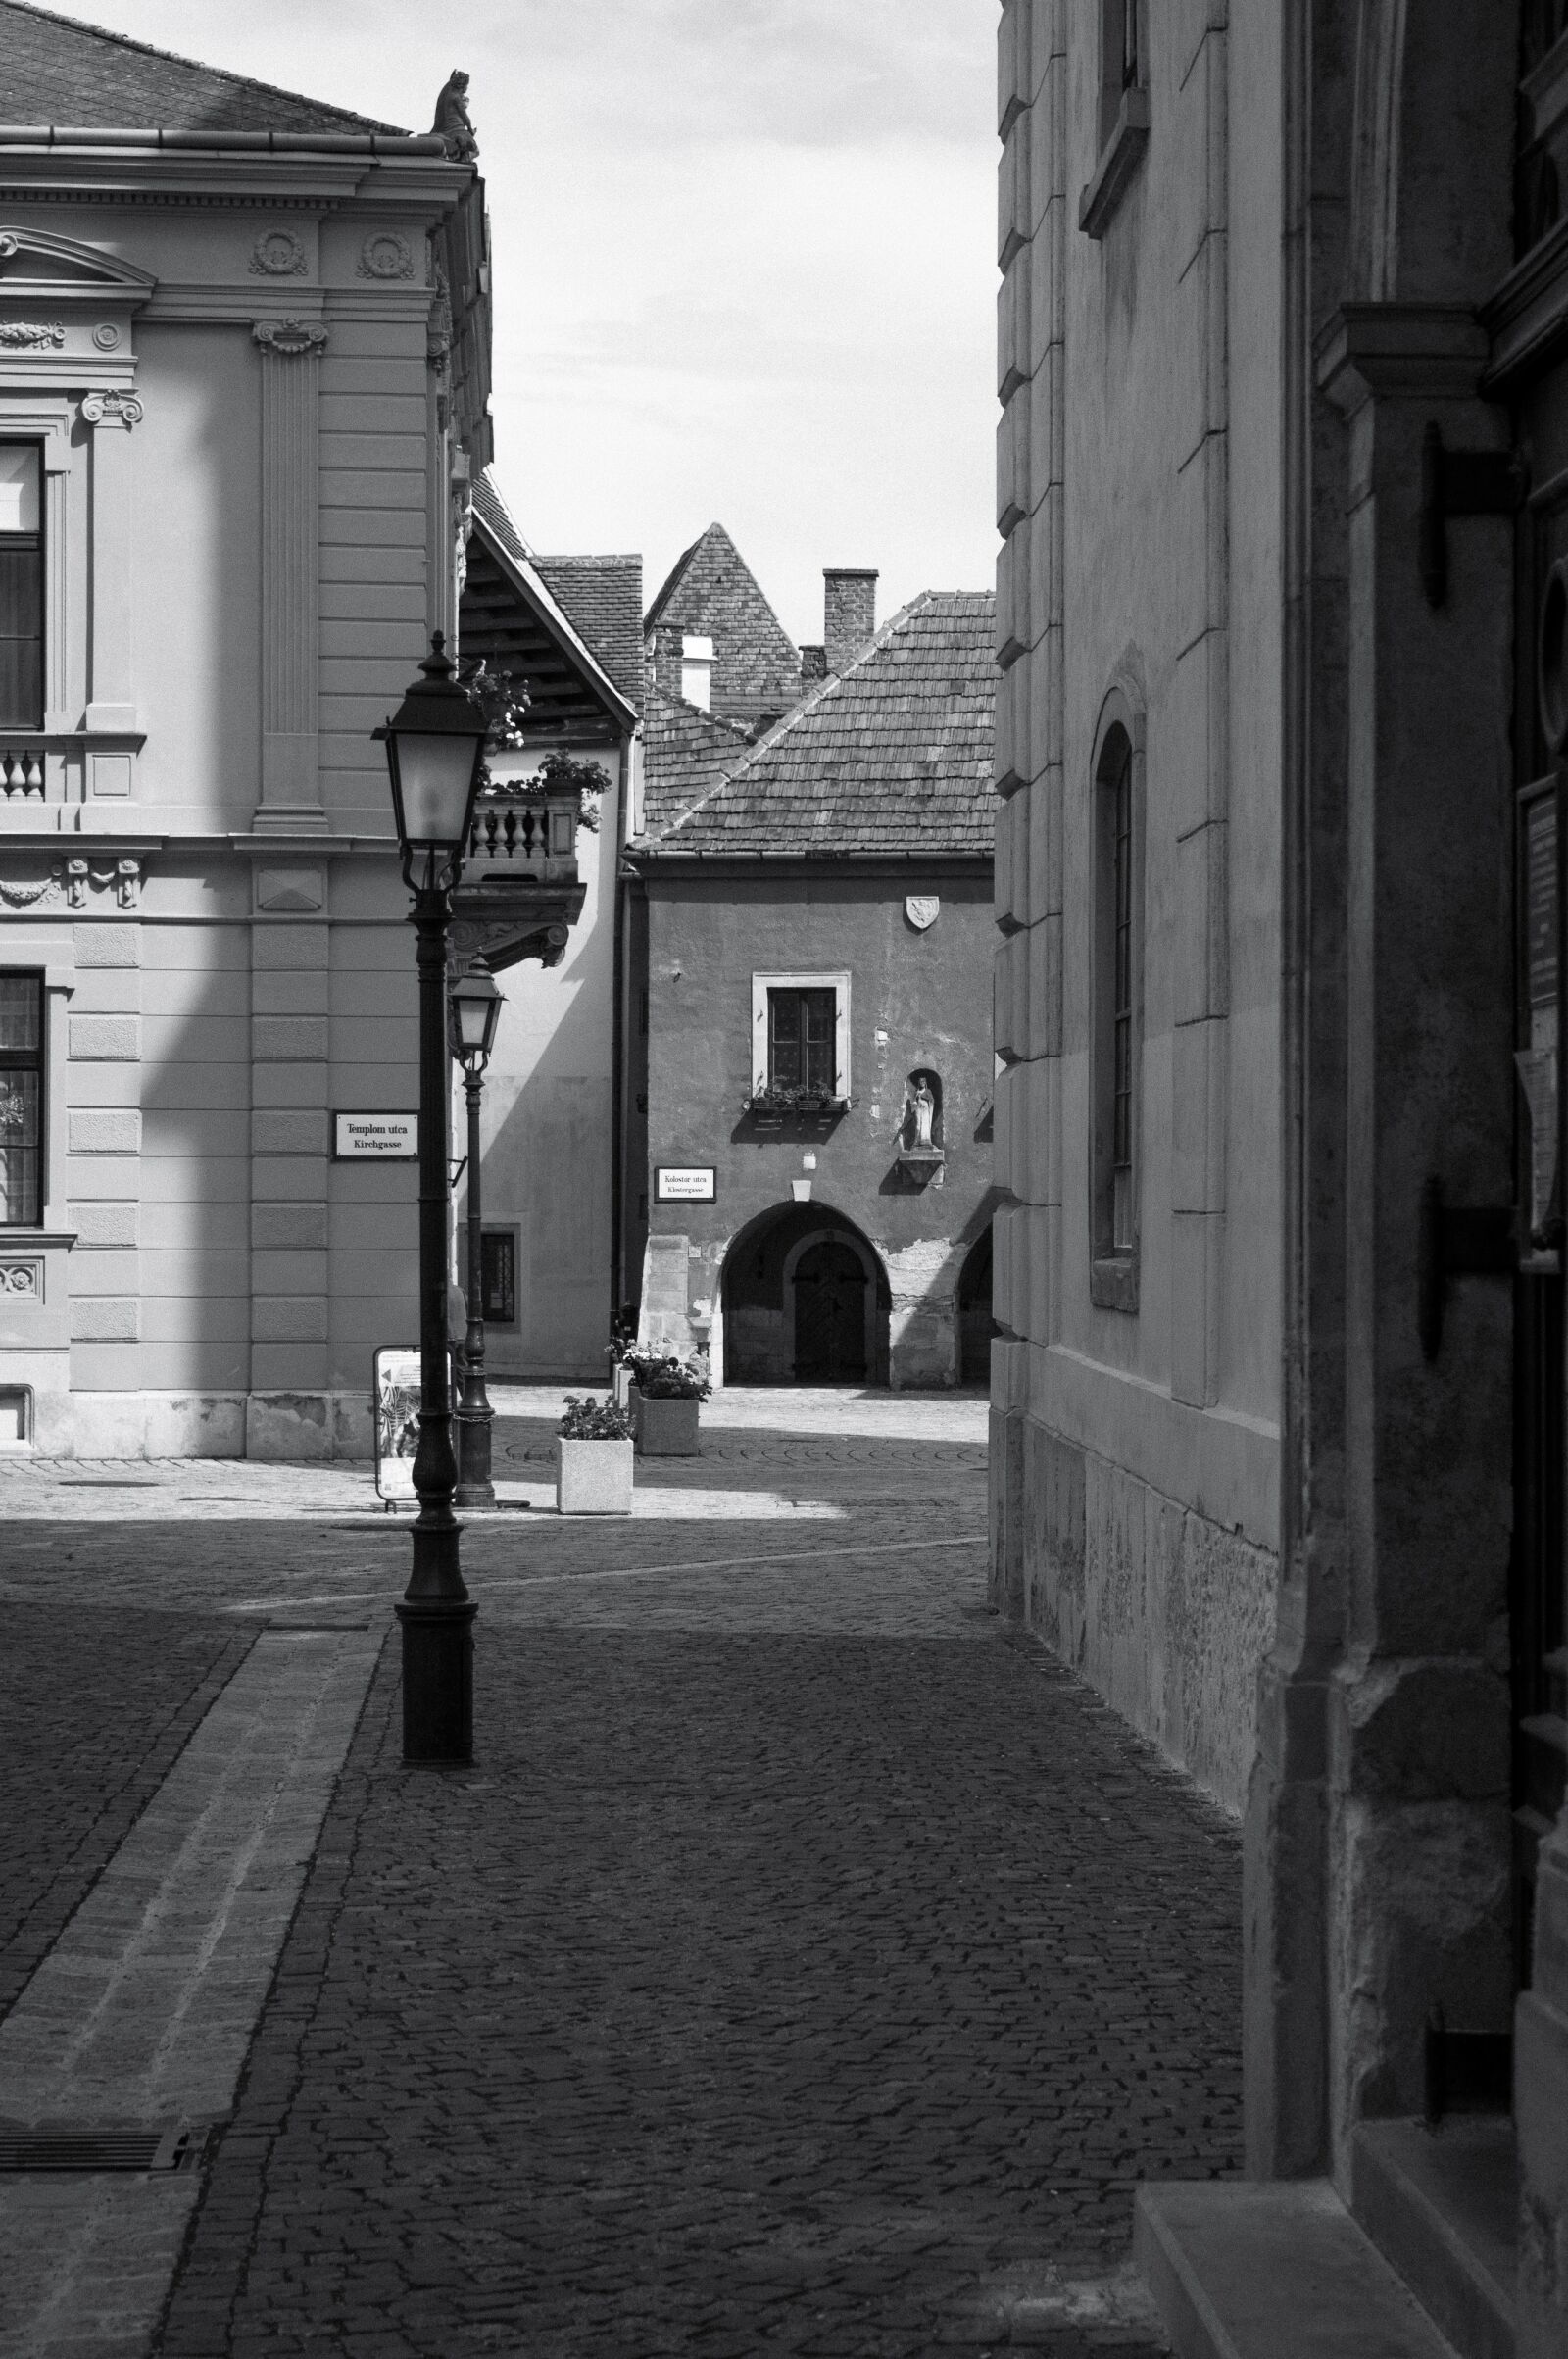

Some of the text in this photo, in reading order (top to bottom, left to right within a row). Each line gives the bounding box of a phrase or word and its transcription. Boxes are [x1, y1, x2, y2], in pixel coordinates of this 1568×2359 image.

[347, 1123, 408, 1136] Templom utca
[354, 1139, 402, 1150] Kirchgasse
